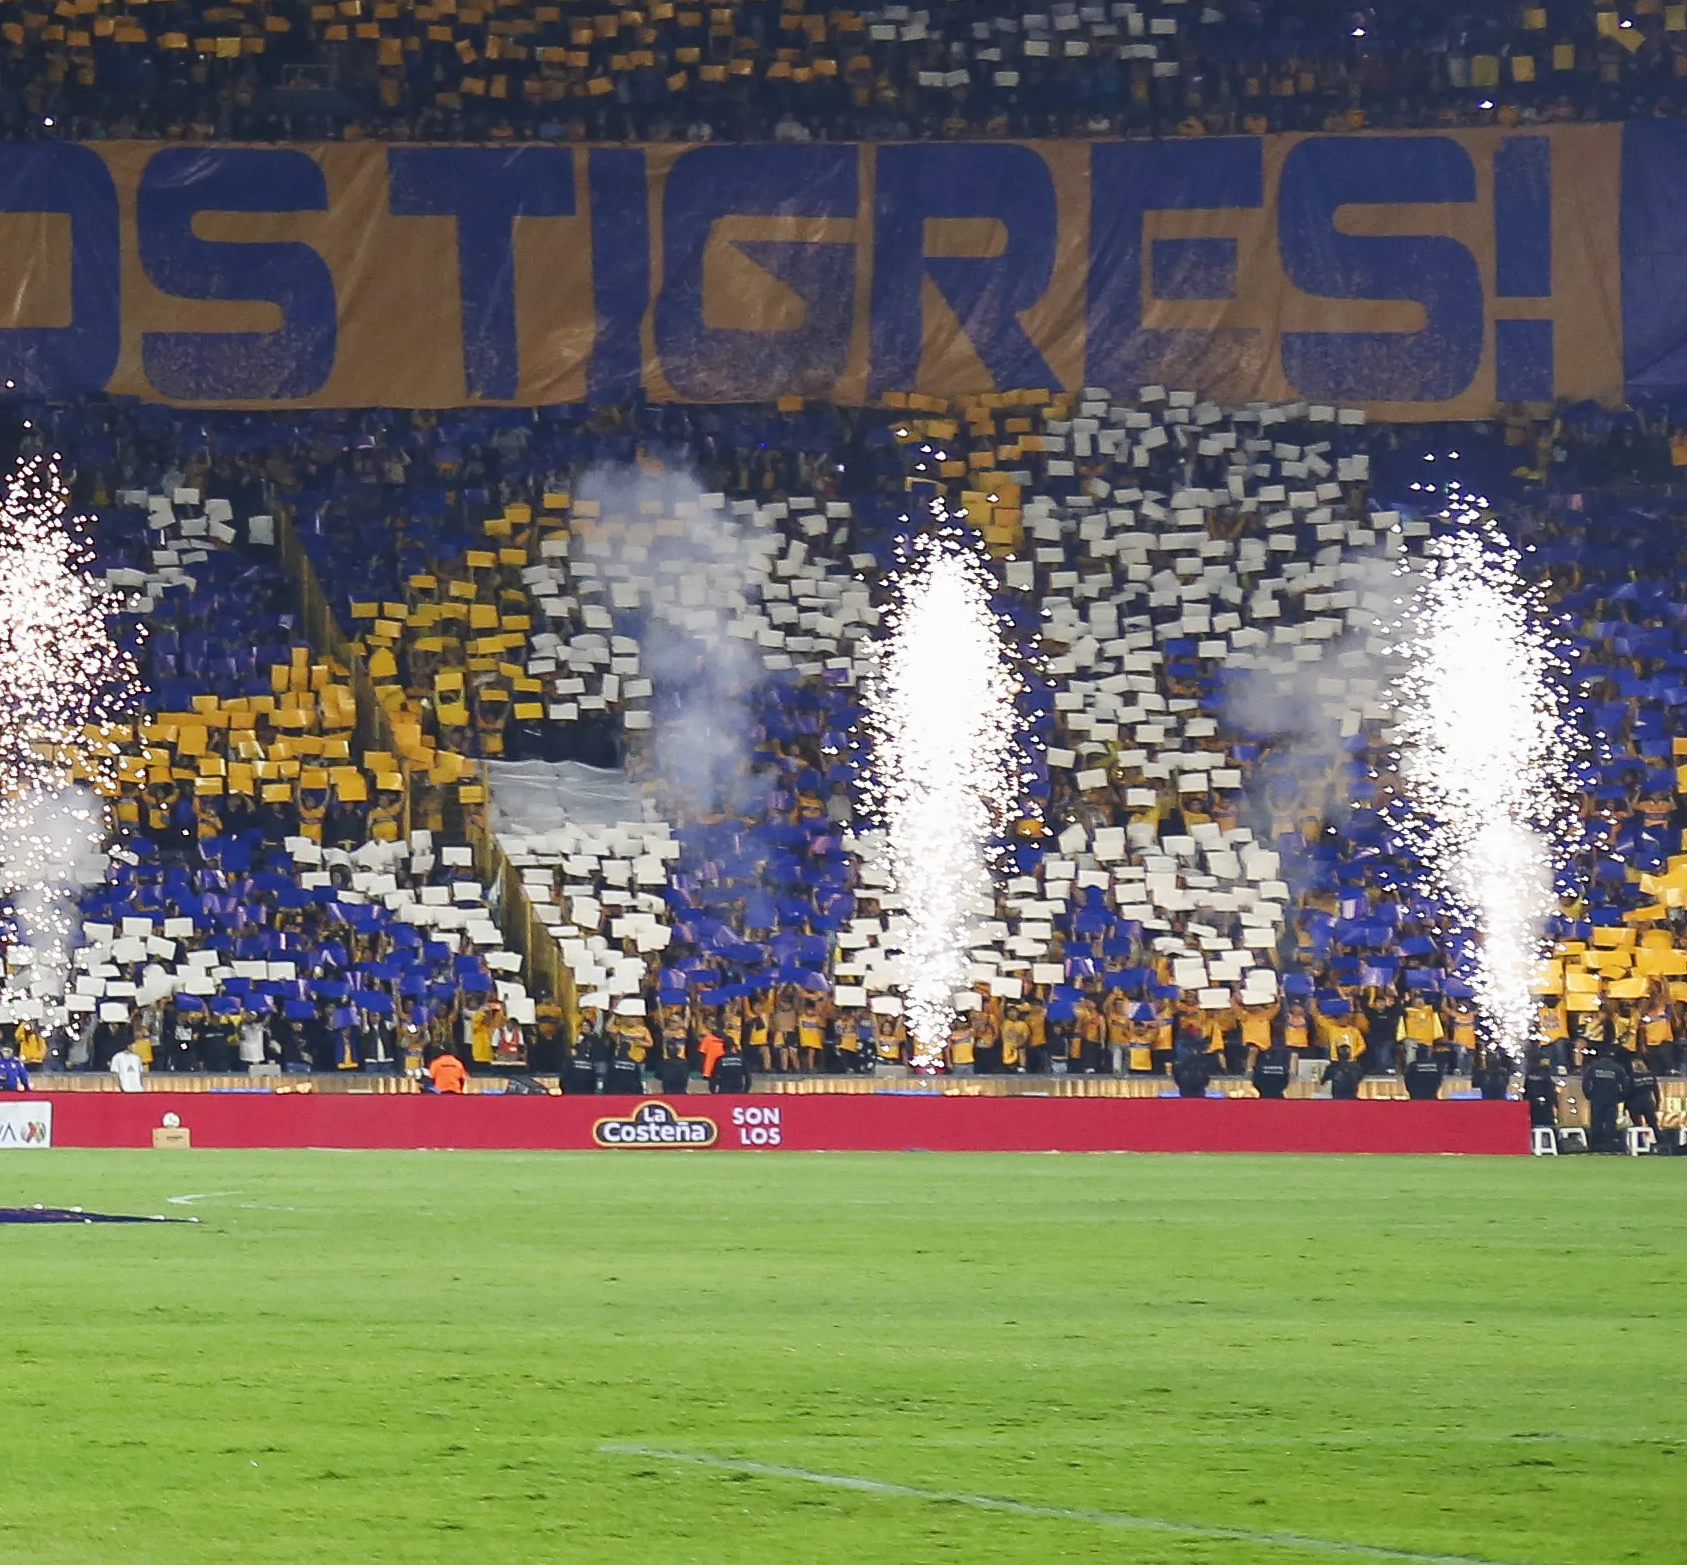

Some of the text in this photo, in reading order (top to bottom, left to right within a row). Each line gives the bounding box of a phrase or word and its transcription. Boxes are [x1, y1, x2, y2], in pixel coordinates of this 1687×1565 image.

[387, 134, 1556, 405] TIGRES!
[643, 1107, 666, 1123] La
[732, 1107, 781, 1125] SON
[602, 1121, 707, 1143] Costeña
[740, 1127, 781, 1146] LOS
